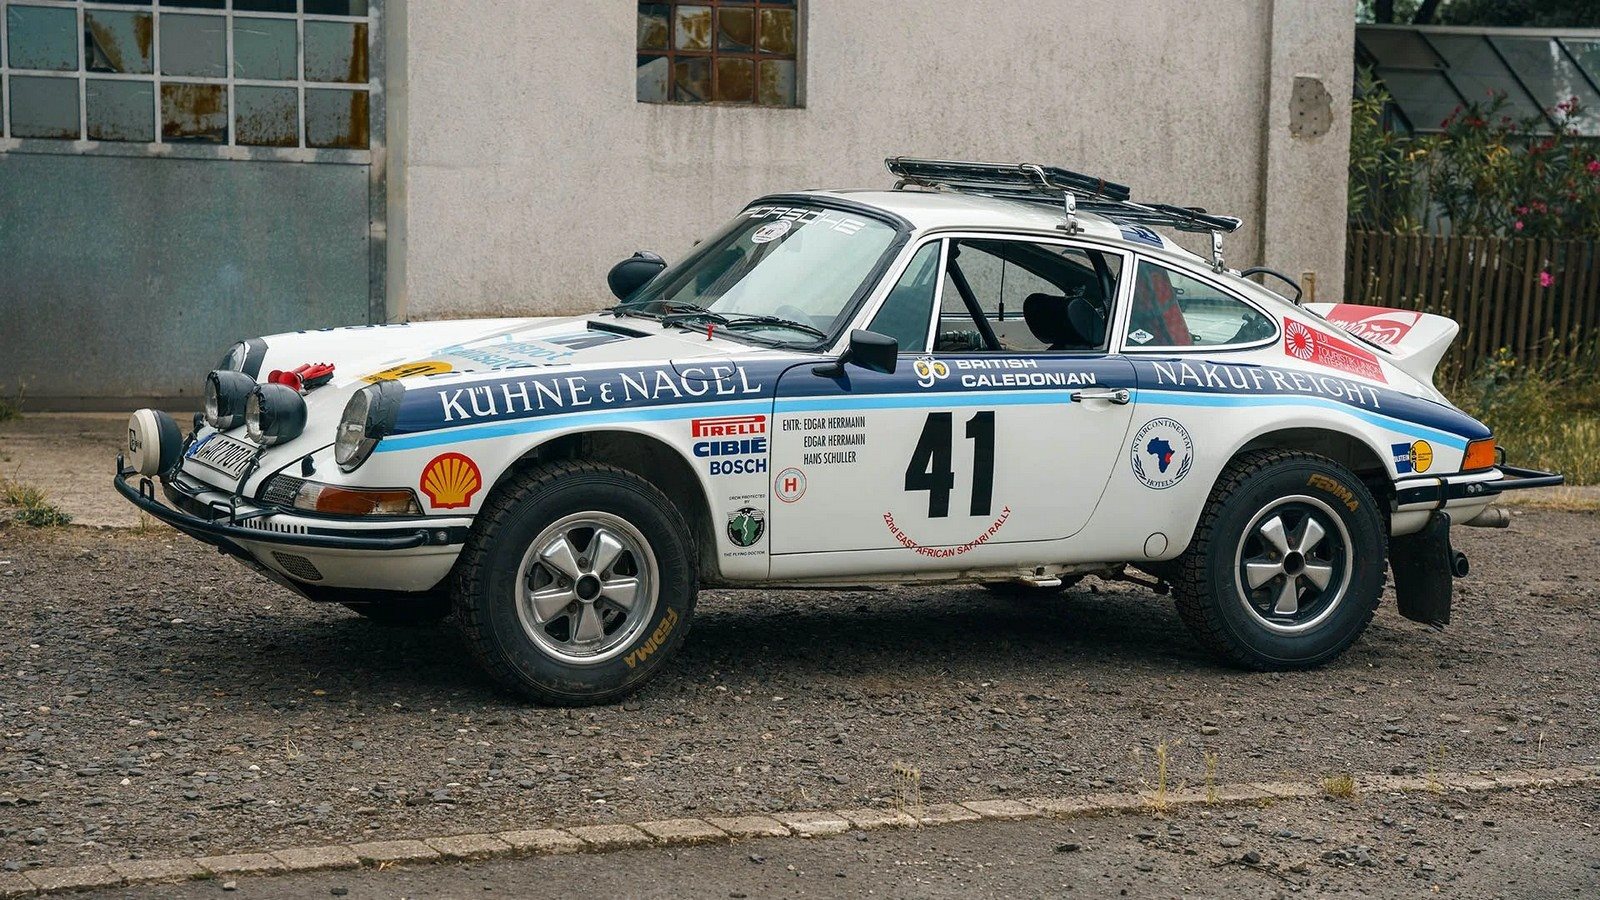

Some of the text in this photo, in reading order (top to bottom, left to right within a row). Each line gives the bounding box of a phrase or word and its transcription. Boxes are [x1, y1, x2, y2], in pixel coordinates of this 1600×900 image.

[734, 206, 866, 236] PORSCHE
[1314, 331, 1329, 344] TUI
[956, 359, 1038, 370] BRITISH
[961, 372, 1097, 388] CALEDONIAN
[1152, 361, 1381, 409] NAKUFREIGHT
[437, 376, 592, 422] KÜHNE
[619, 366, 762, 402] NAGEL
[691, 415, 766, 437] PIRELLI
[782, 416, 866, 431] ENTR: EDGAR HERRMANN
[804, 433, 866, 448] EDGAR HERRMANN
[1133, 420, 1191, 452] INTERCONTINENTAL
[710, 458, 767, 475] BOSCH
[803, 450, 857, 465] HANS SCHULLER
[904, 410, 995, 518] 41
[784, 477, 797, 493] H
[1146, 479, 1174, 487] HOTELS
[1306, 473, 1359, 512] FEDIMA
[883, 506, 1011, 557] 22nd EAST AFRICAN SAFARI RALLY
[623, 606, 678, 669] FEDIMA
